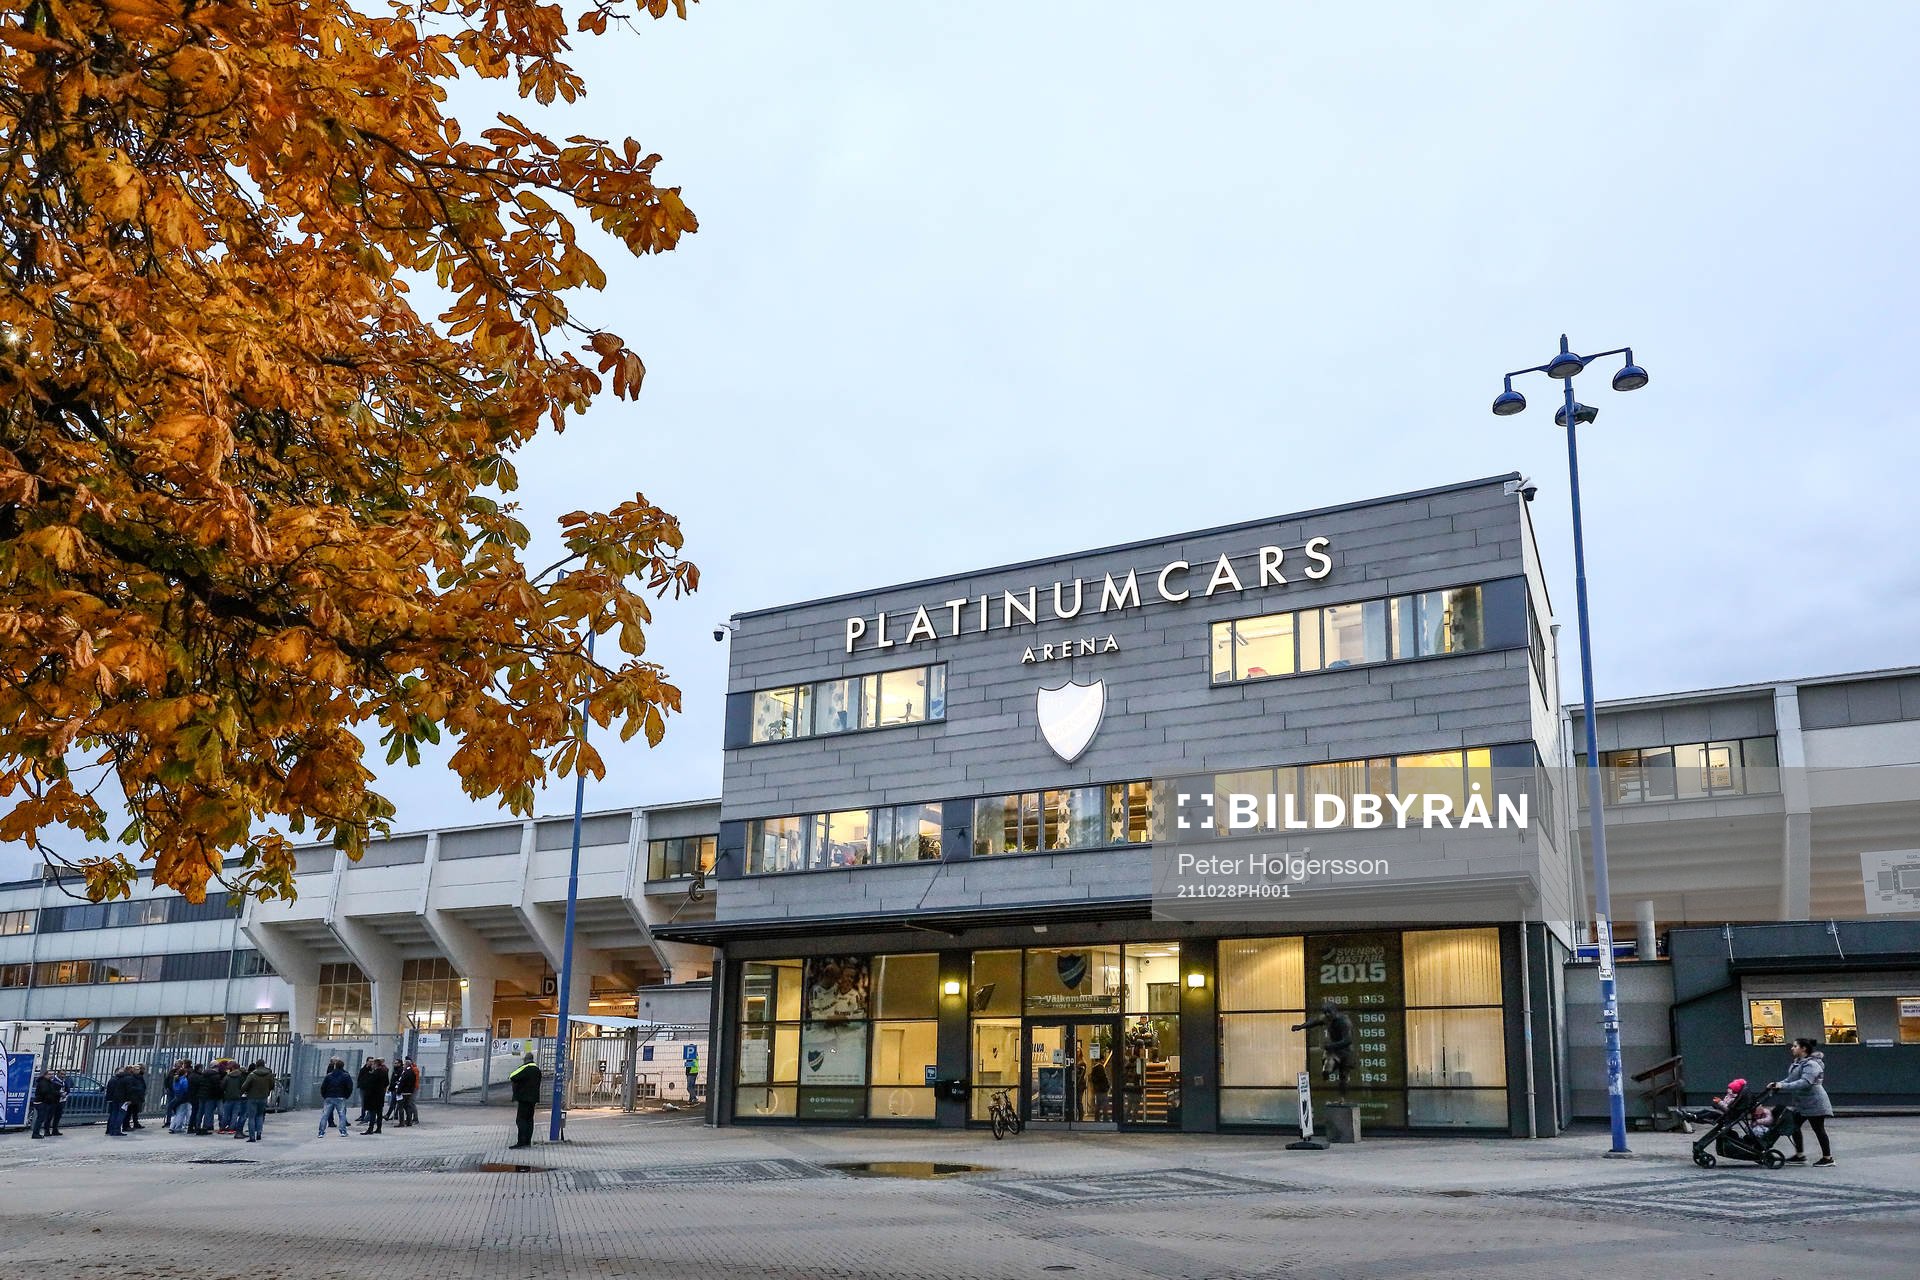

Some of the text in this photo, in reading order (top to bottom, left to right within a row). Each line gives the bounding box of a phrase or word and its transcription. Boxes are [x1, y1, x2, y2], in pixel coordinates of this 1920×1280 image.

[846, 536, 1333, 653] PLATINUMCARS
[1020, 633, 1120, 665] ARENA
[1320, 963, 1387, 984] 2015
[545, 980, 555, 994] D
[1359, 995, 1385, 1004] 1963
[1359, 1014, 1386, 1023] 1960
[1359, 1029, 1386, 1038] 1956
[464, 1035, 480, 1044] Entré
[686, 1047, 695, 1058] P
[1032, 1043, 1045, 1053] LVA
[1360, 1044, 1387, 1053] 1948
[1360, 1059, 1387, 1068] 1946
[1361, 1074, 1388, 1083] 1943
